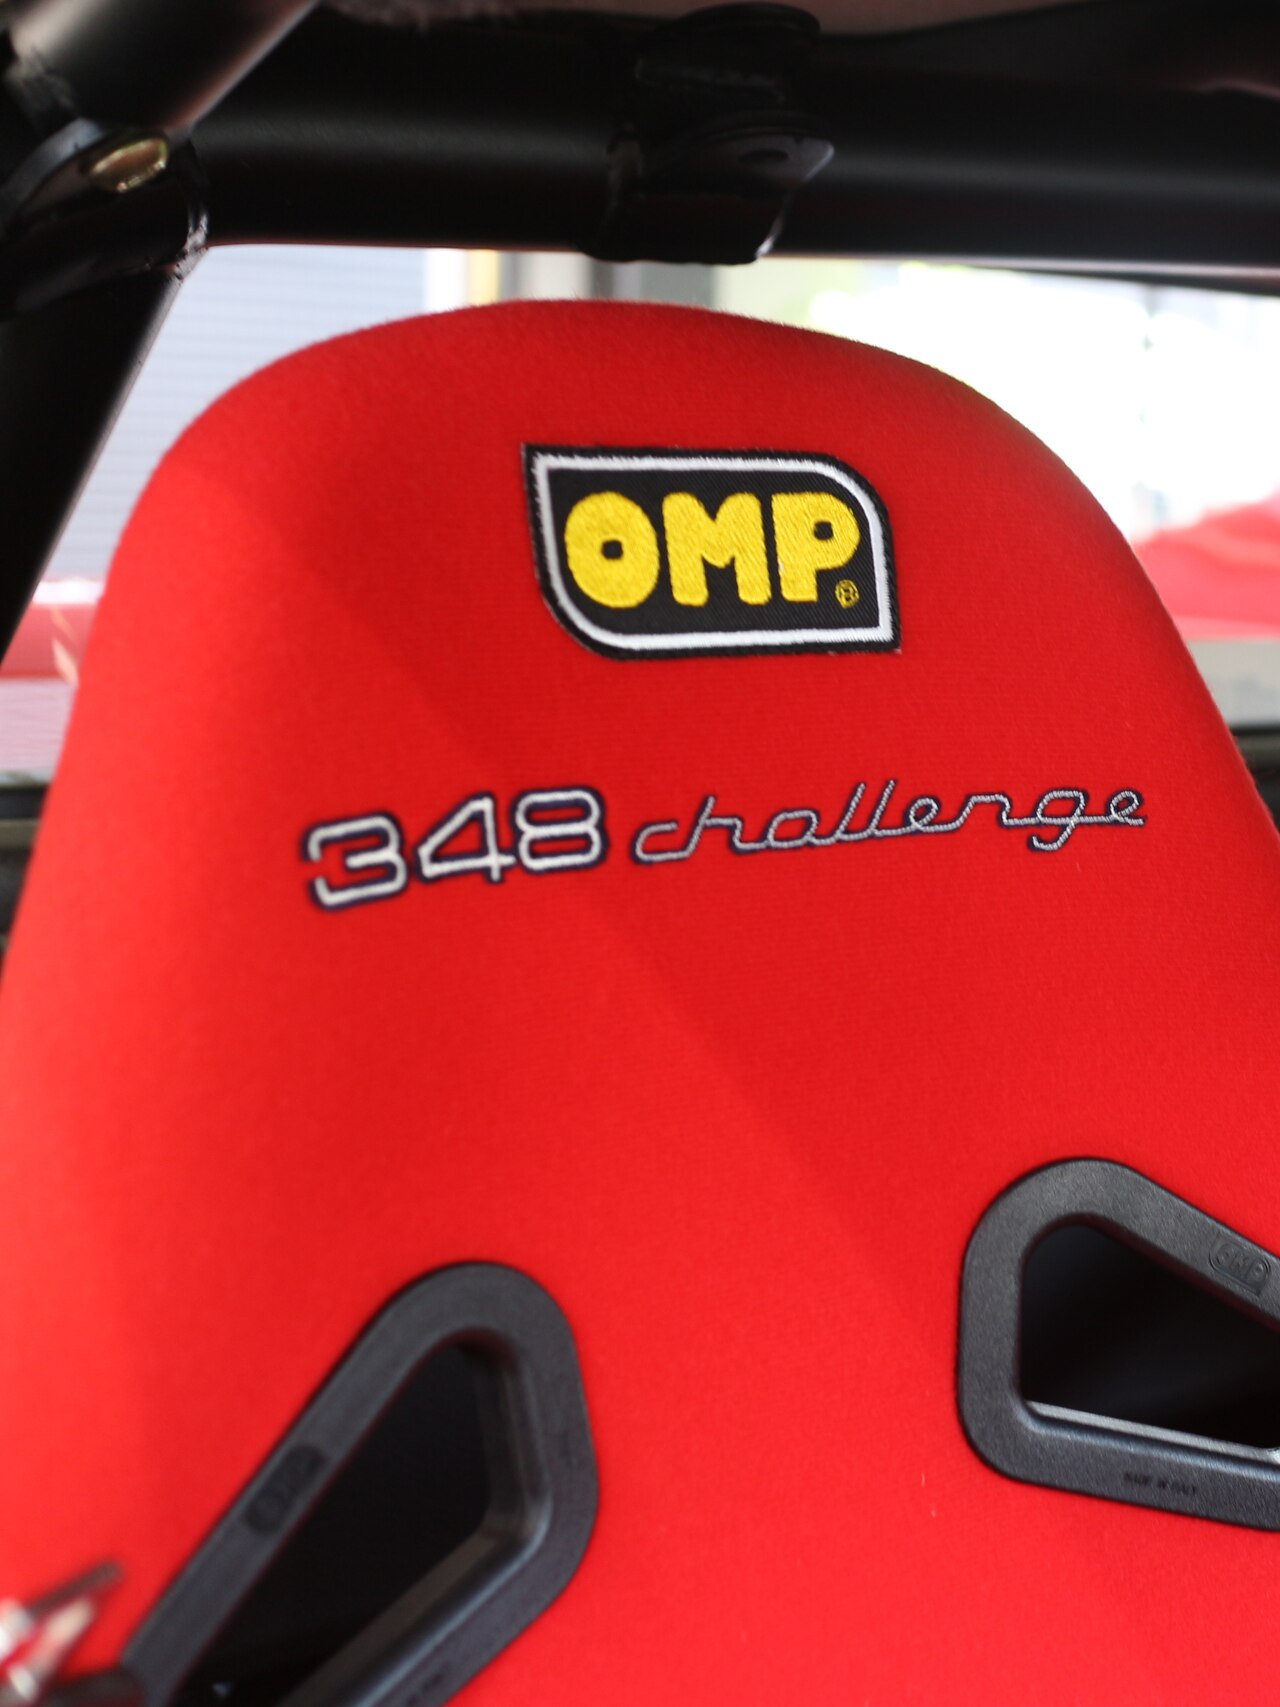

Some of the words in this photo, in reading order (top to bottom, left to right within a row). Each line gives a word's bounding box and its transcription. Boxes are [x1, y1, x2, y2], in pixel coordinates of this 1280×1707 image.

[564, 491, 860, 608] OMP
[304, 787, 607, 910] 348
[634, 780, 1145, 862] challenge
